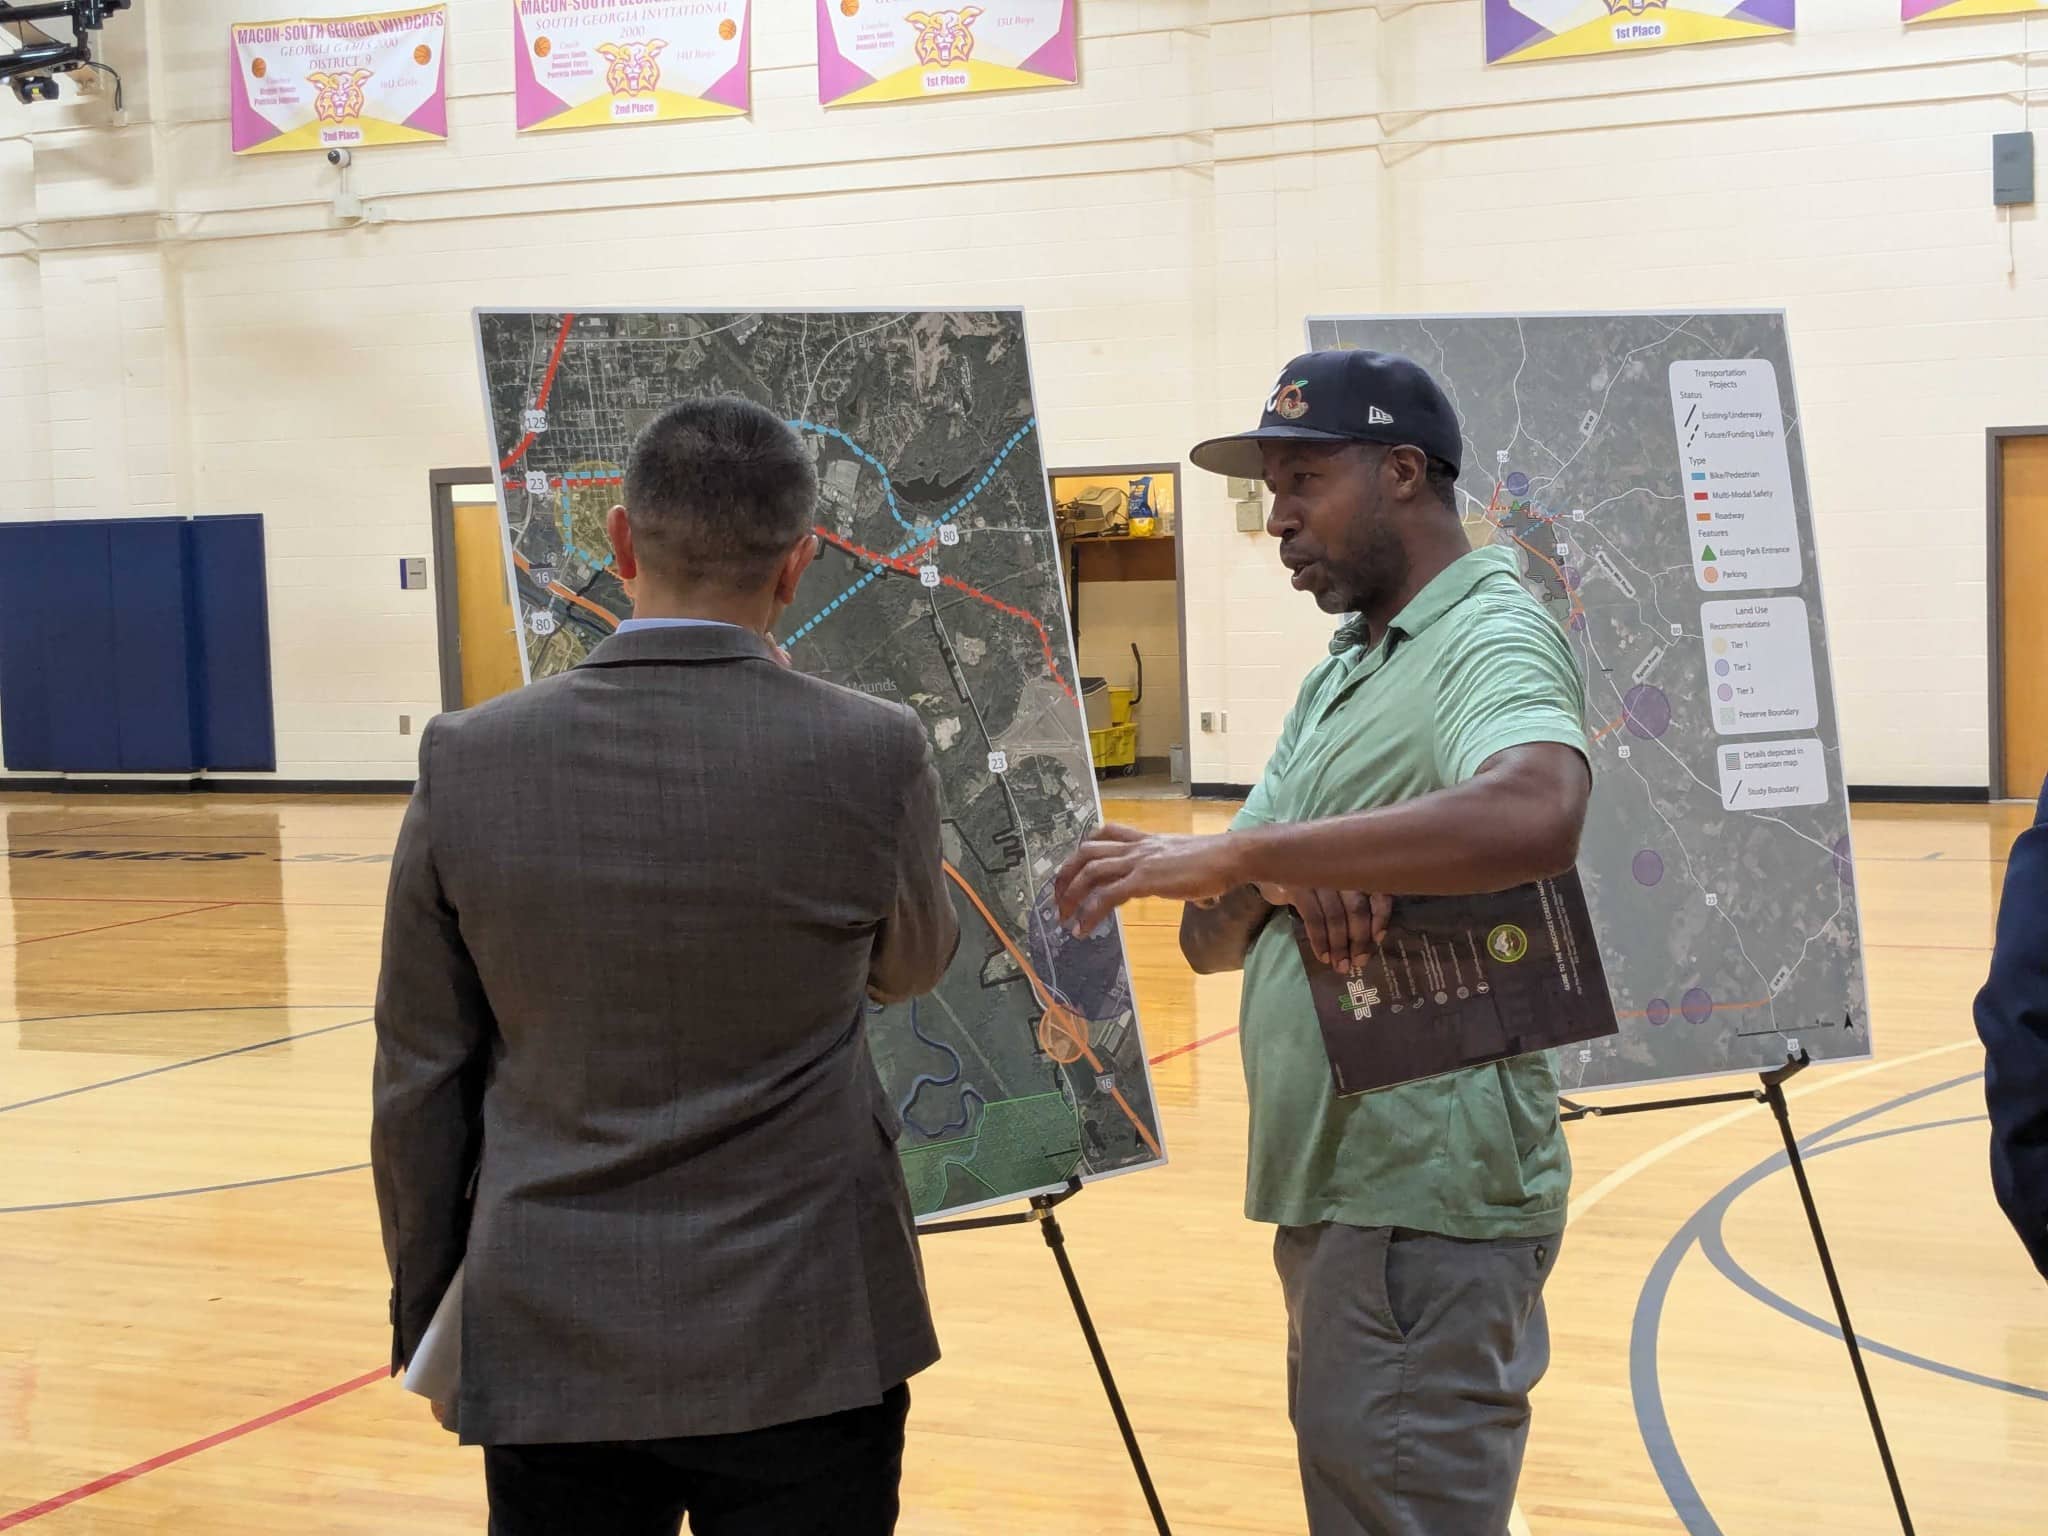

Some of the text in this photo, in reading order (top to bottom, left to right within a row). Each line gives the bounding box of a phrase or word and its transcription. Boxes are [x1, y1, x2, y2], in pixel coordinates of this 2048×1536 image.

[535, 15, 579, 31] SOUTH
[583, 10, 639, 27] GEORGIA
[641, 4, 727, 23] INVITATIONAL
[238, 11, 444, 45] MACON-SOUTH GEORGIA WILDCATS
[619, 26, 646, 39] 2000
[1616, 25, 1661, 39] 1st Place
[280, 43, 330, 57] GEORGIA
[309, 55, 372, 70] DISTRICT 9
[926, 74, 965, 87] 1st Place
[615, 103, 654, 115] 2nd Place
[323, 130, 360, 142] 2nd Place
[1694, 369, 1747, 379] Transportation
[1709, 380, 1738, 390] Projects
[1680, 391, 1703, 400] Status
[1702, 411, 1762, 421] Existing/Underway
[527, 417, 546, 429] 129
[1704, 430, 1775, 440] Future/Funding Likely
[1688, 456, 1706, 466] Type
[1710, 470, 1760, 480] Bike/Pedestrian
[530, 479, 544, 490] 23
[1712, 489, 1774, 500] Multi-Modal Safety
[1715, 512, 1745, 521] Roadway
[944, 531, 955, 542] 80
[1698, 529, 1729, 538] Features
[1720, 545, 1790, 558] Existing Park Entrance
[536, 572, 549, 584] 16
[925, 572, 936, 583] 23
[1722, 570, 1748, 579] Parking
[1735, 606, 1768, 615] Land Use
[536, 619, 550, 631] 80
[1709, 620, 1770, 631] Recommendations
[1731, 641, 1743, 649] Tier
[1736, 687, 1748, 695] Tier
[1739, 707, 1799, 719] Preserve Boundary
[1743, 750, 1766, 759] Details
[1767, 748, 1797, 758] depicted
[992, 759, 1004, 770] 23
[1744, 760, 1799, 770] companion map
[1747, 784, 1799, 796] Study Boundary
[1556, 951, 1564, 963] THE
[1102, 1079, 1111, 1089] 16
